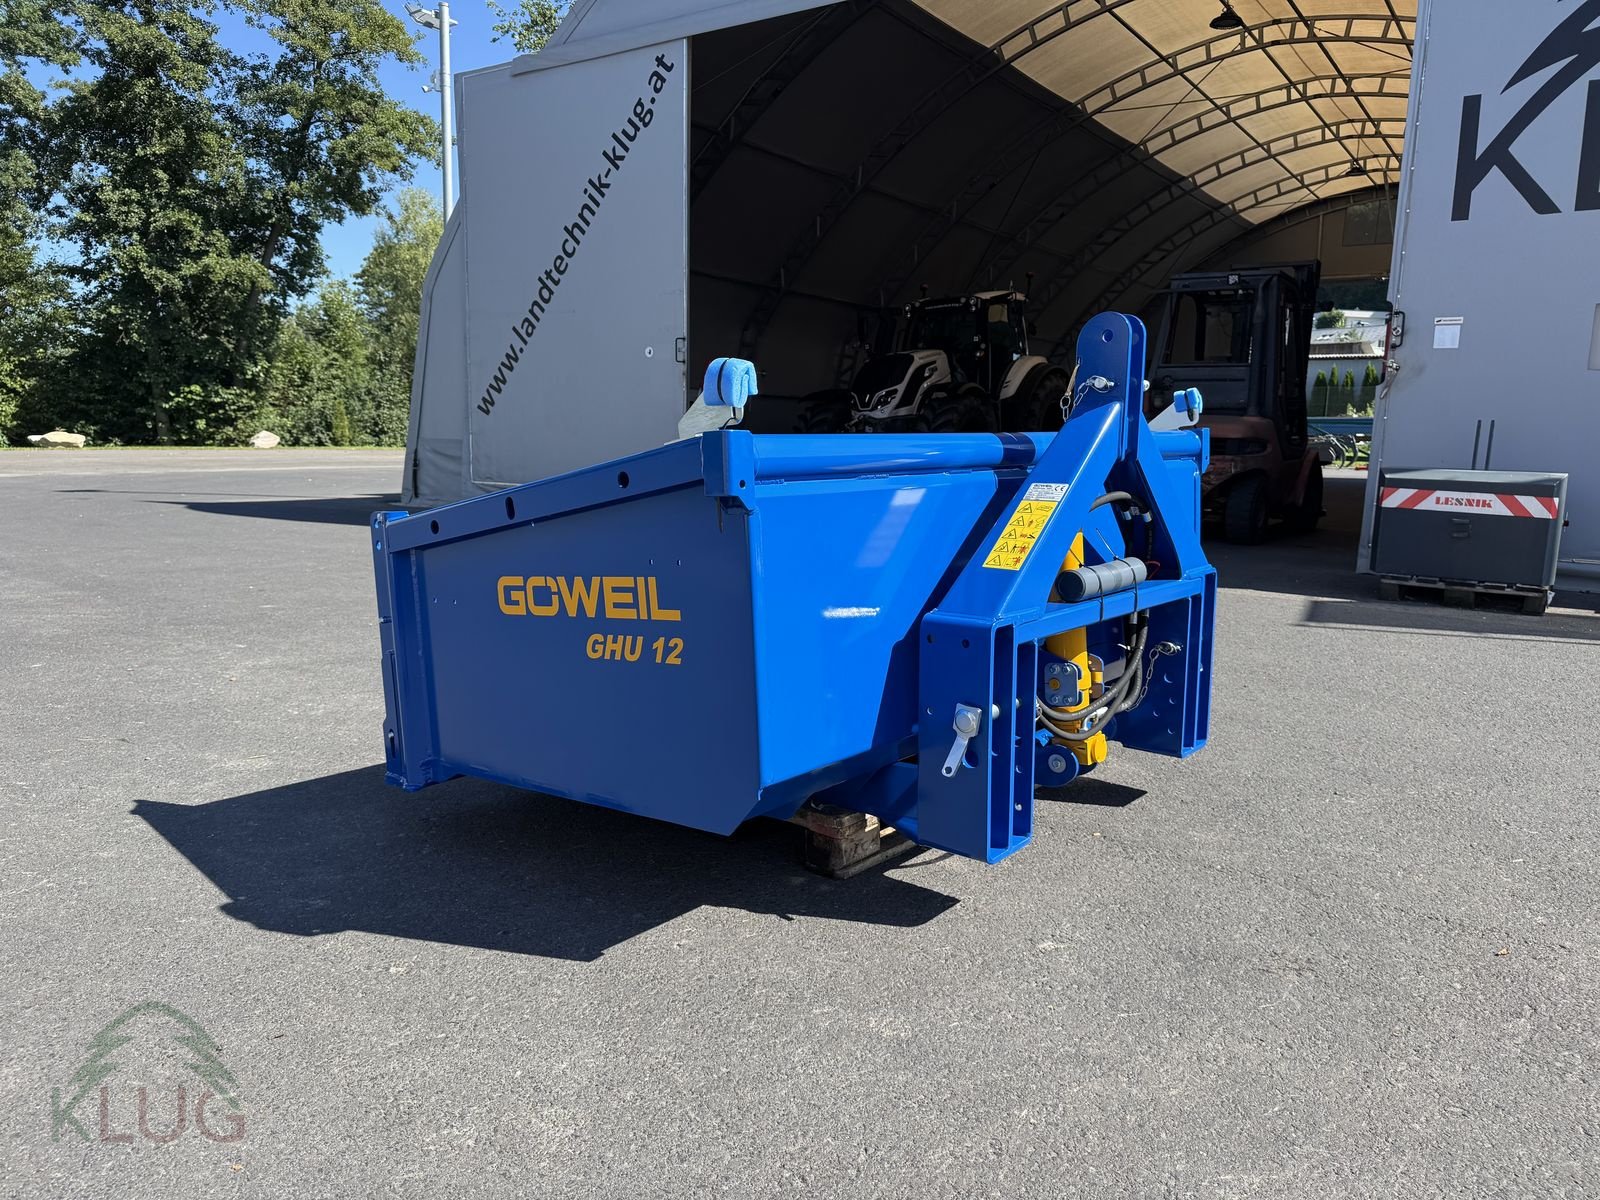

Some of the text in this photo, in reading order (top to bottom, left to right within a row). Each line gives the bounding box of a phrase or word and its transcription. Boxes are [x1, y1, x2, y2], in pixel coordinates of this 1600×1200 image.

[477, 53, 675, 415] www.landtechnik-klug.at
[1435, 496, 1493, 508] LESNIK
[586, 633, 684, 664] GHU 12
